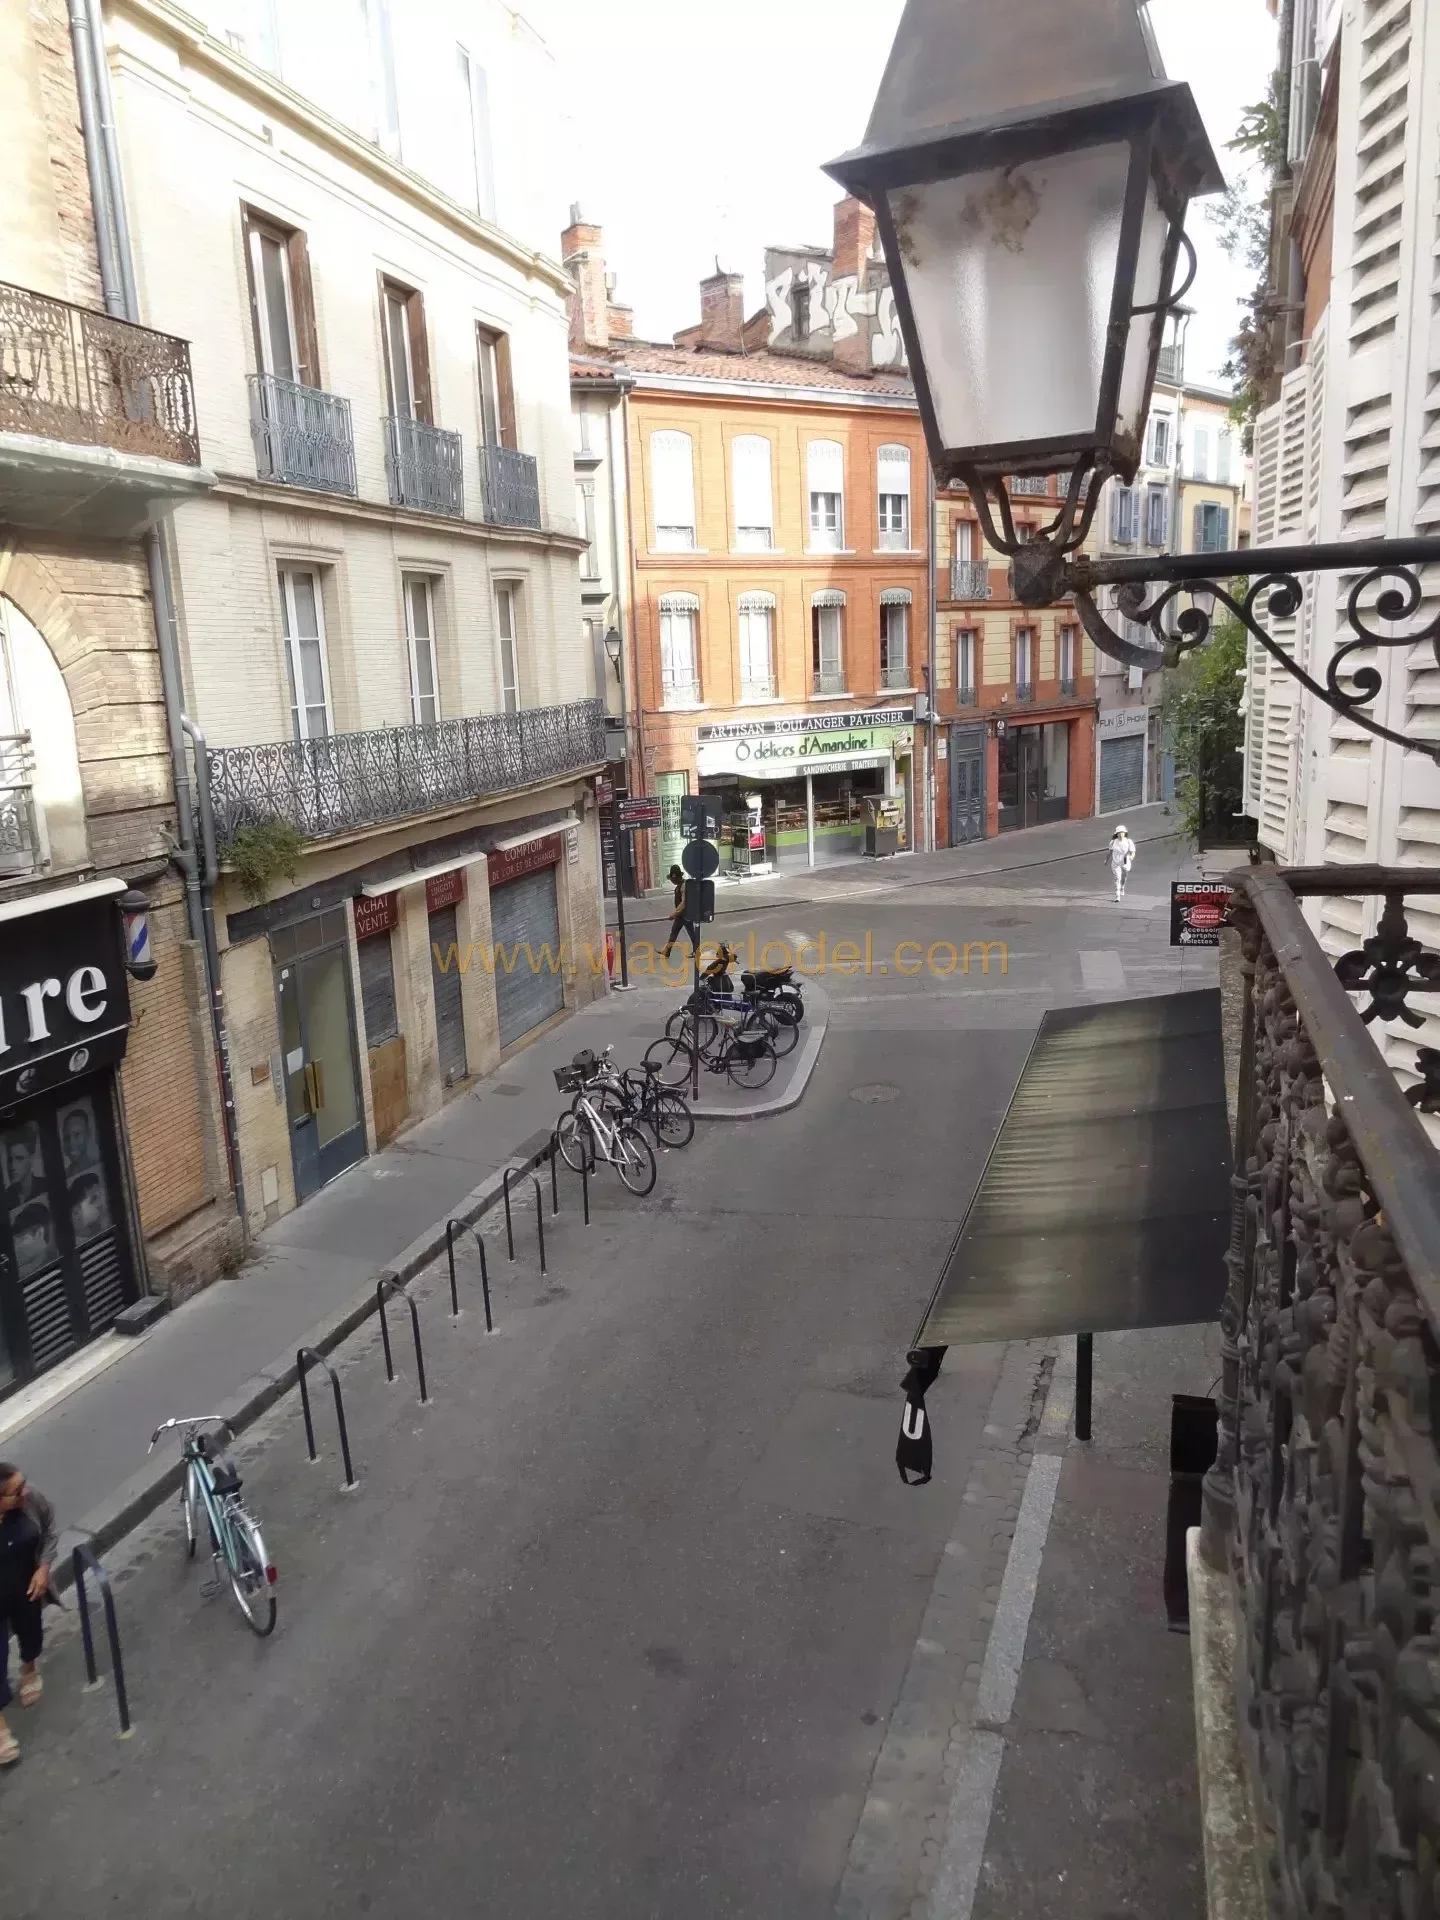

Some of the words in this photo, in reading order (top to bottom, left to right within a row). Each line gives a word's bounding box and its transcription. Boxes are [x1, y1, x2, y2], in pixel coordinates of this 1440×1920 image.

[710, 722, 765, 738] ARTISAN
[774, 715, 845, 732] BOULANGER
[850, 711, 905, 726] PATISSIER
[754, 740, 795, 760] délices
[803, 762, 847, 775] SANDWICHERIE
[851, 759, 878, 770] TRAITEUR
[504, 838, 543, 862] COMPTOIR
[534, 848, 556, 864] CHANGE
[356, 895, 388, 917] ACHAT
[358, 911, 390, 933] VENTE
